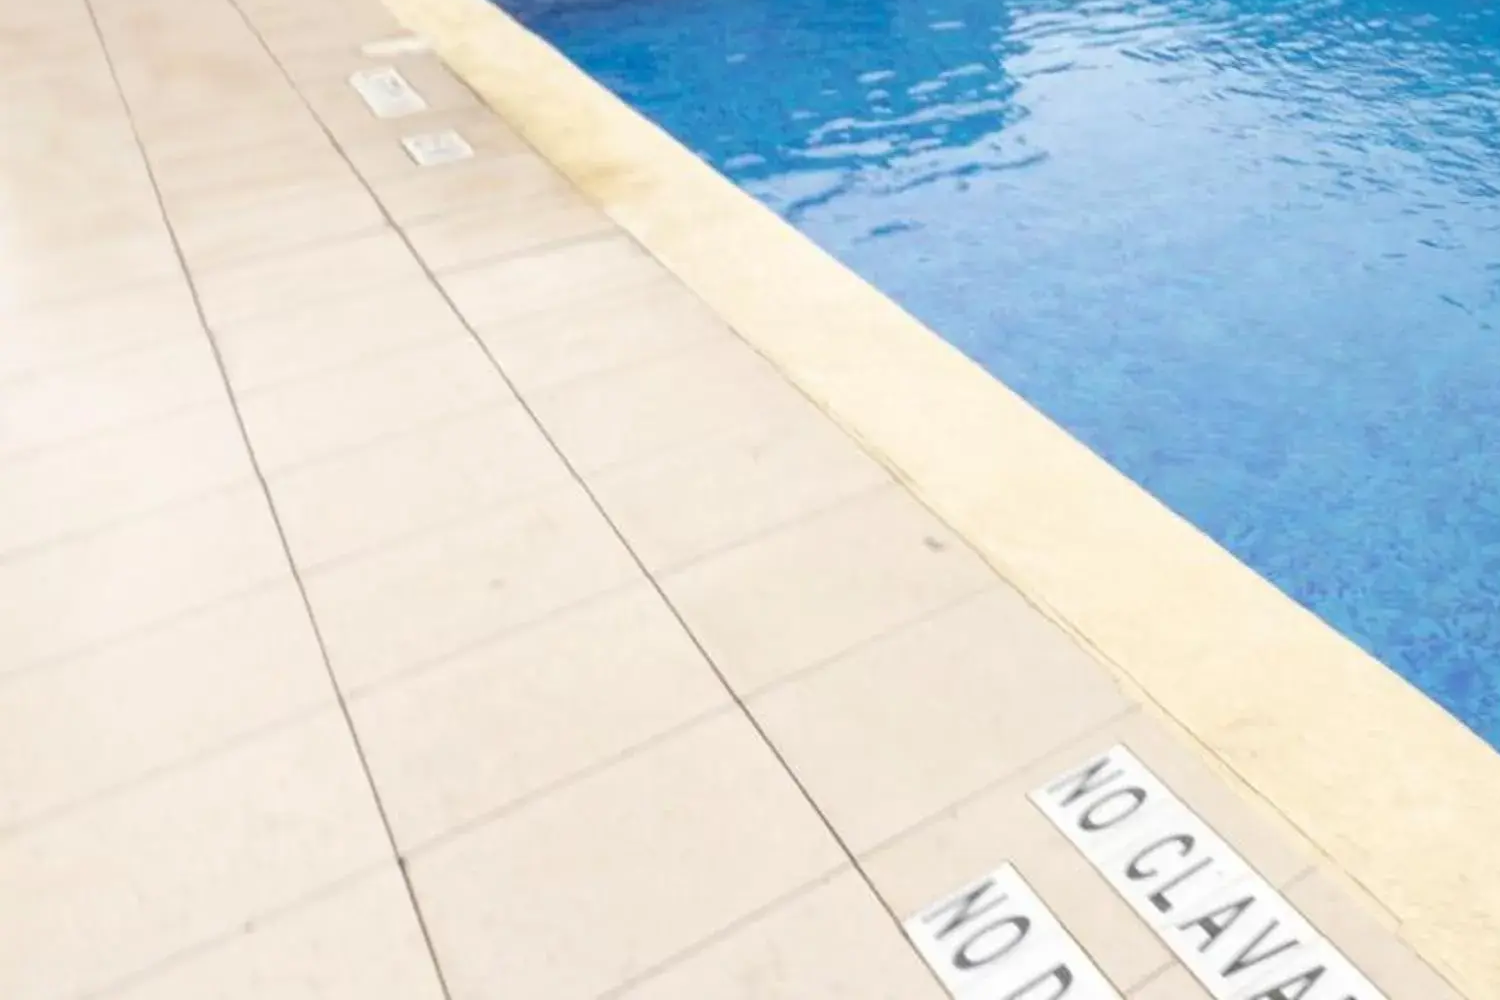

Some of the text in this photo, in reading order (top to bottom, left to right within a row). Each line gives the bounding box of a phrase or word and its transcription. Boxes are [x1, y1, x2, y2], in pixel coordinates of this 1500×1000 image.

[921, 877, 1031, 970] NO
[1046, 756, 1358, 1000] NO CLAVA
